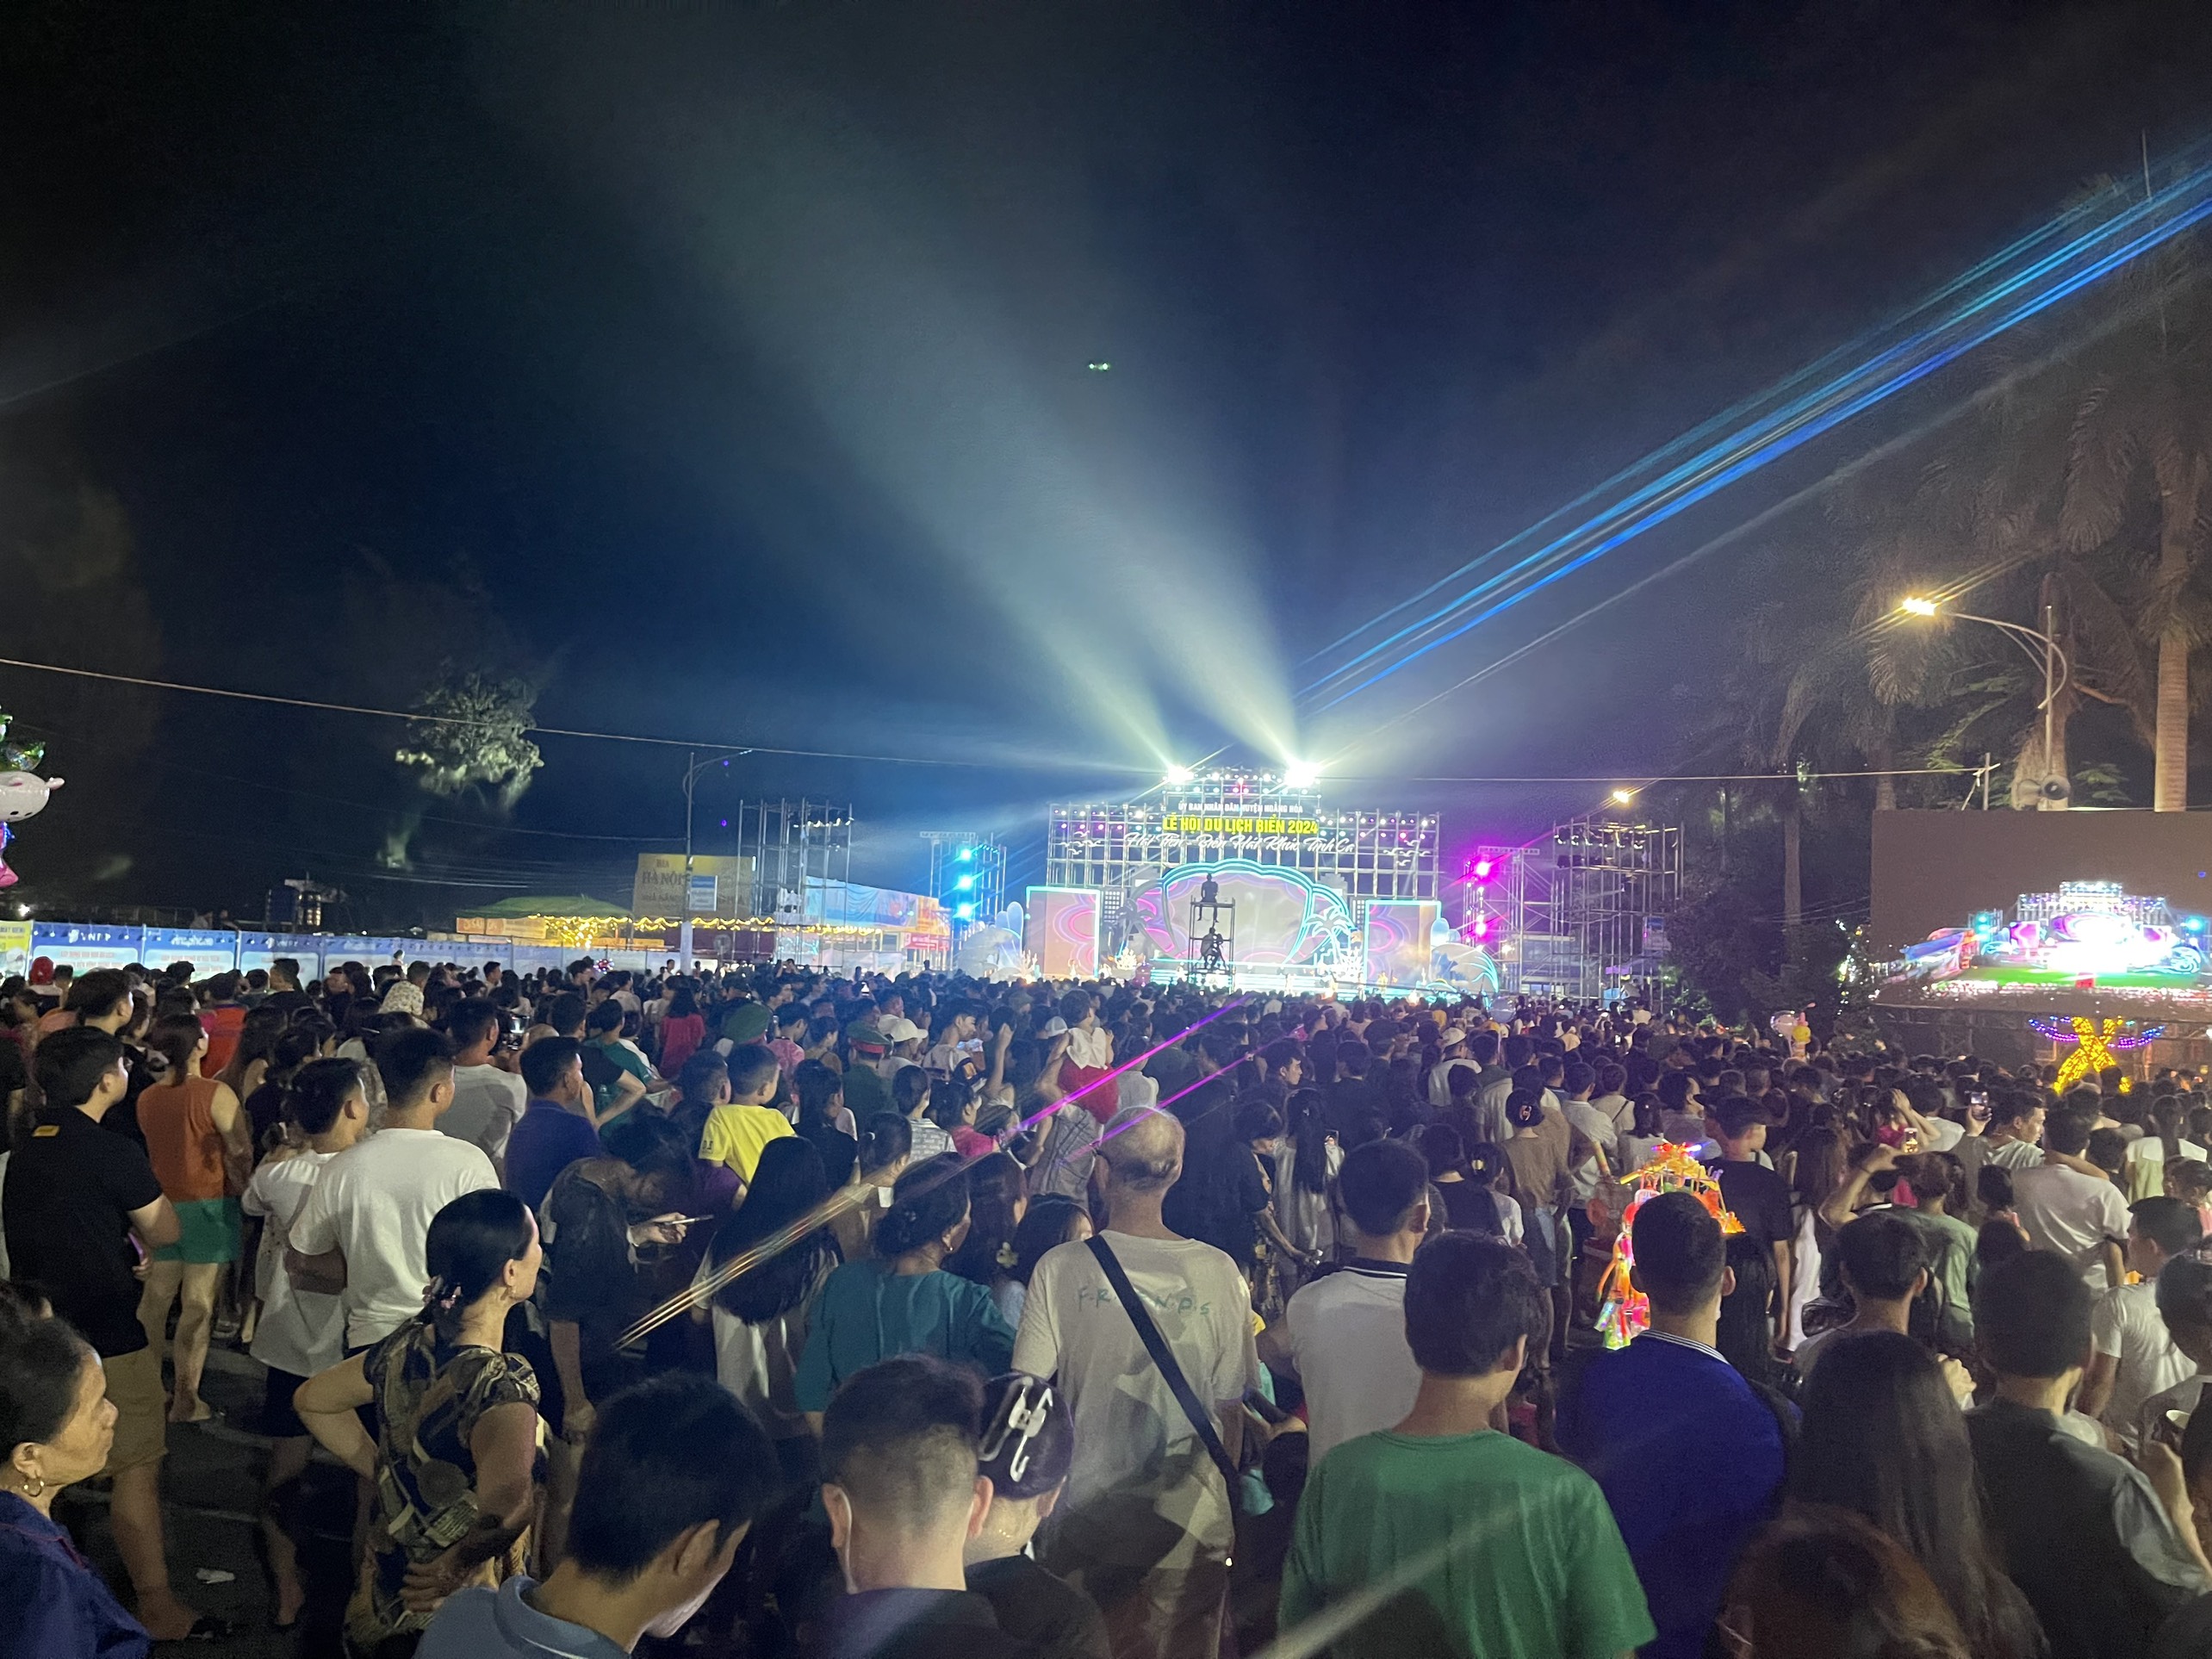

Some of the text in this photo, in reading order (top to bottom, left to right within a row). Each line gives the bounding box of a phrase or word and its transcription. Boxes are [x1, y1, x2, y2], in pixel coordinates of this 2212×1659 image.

[1163, 812, 1319, 835] LỄ HỘI DU LỊCH BIỂN 2024
[1229, 835, 1263, 850] Hát
[1336, 837, 1356, 853] Ca
